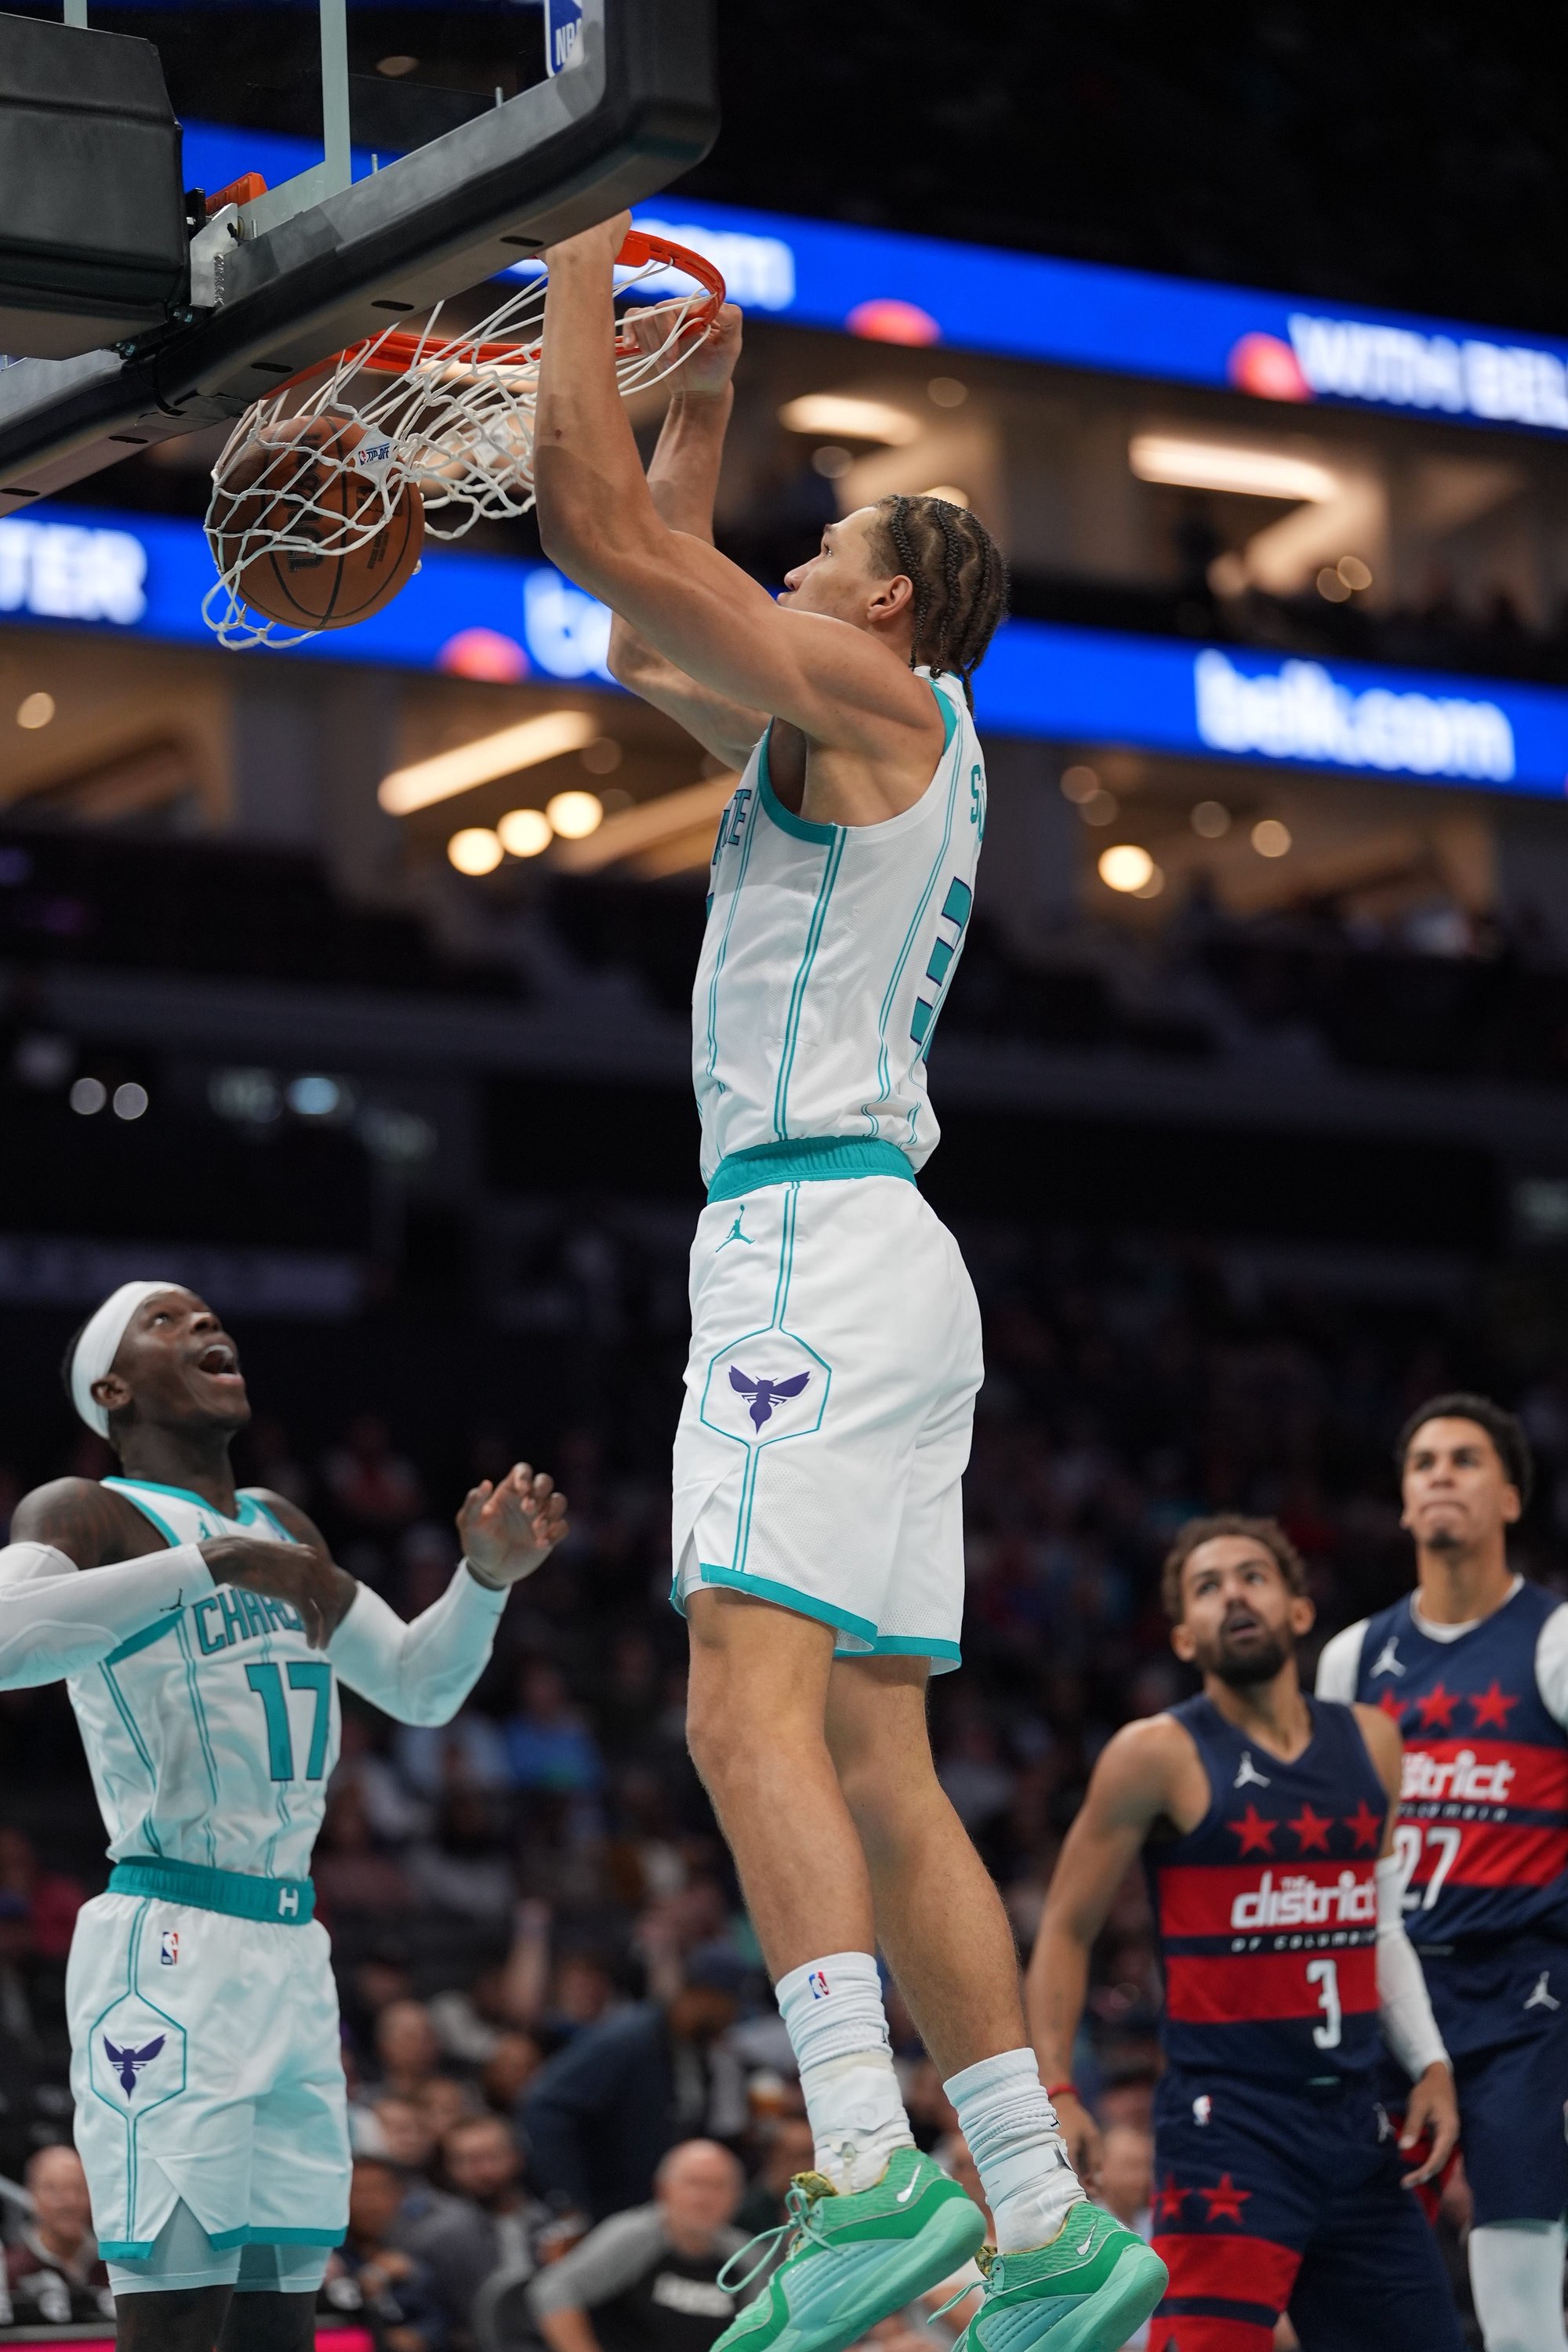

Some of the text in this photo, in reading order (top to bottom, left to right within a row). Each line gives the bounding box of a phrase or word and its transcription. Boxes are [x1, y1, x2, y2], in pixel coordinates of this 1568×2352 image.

[1194, 648, 1515, 782] belk.com
[192, 1588, 305, 1656] CHARL
[244, 1662, 331, 1781] 17
[1400, 1749, 1515, 1802] strict
[1393, 1826, 1461, 1911] 27
[1306, 1959, 1341, 2049] 3
